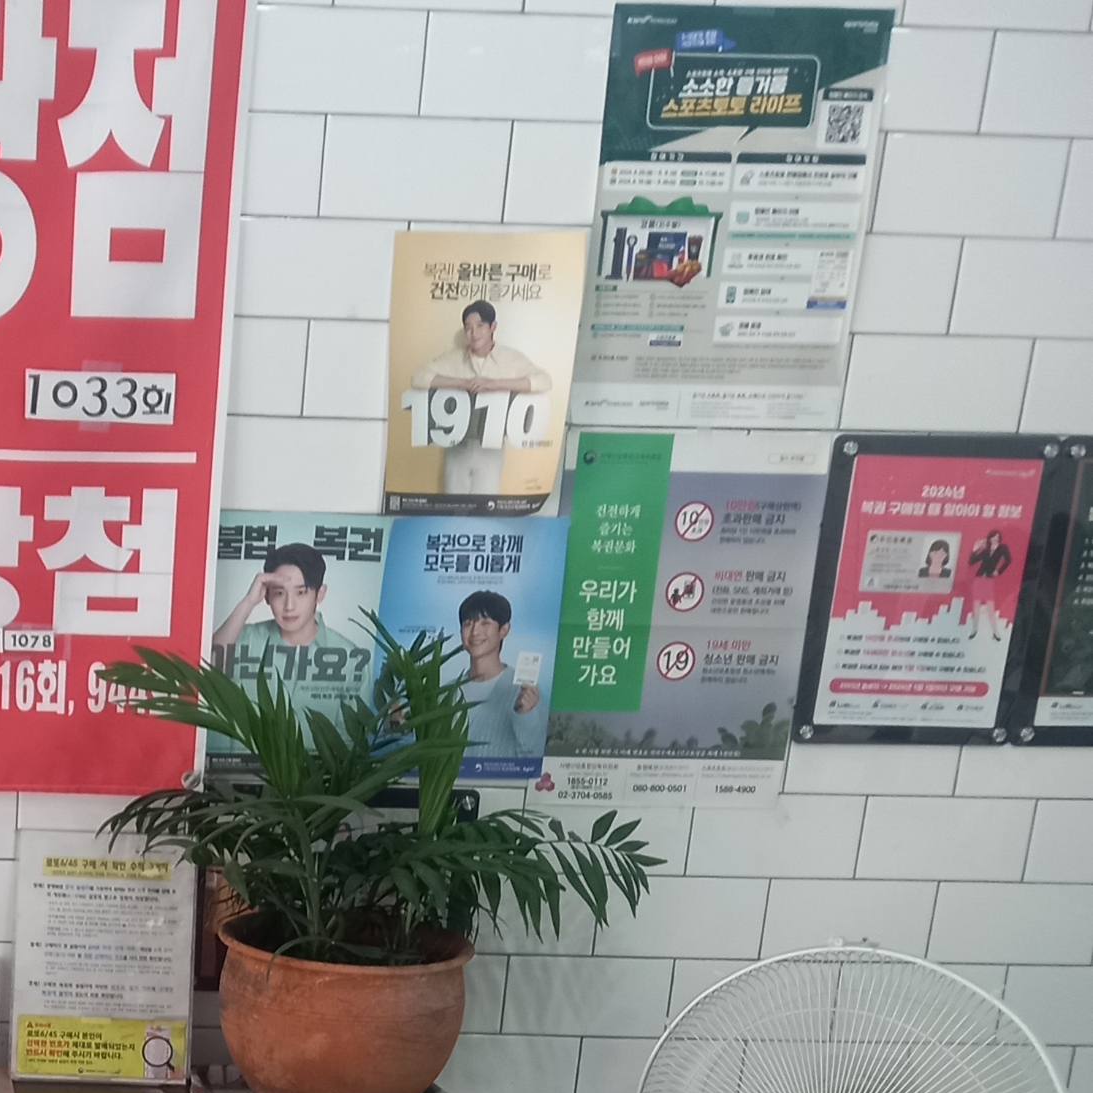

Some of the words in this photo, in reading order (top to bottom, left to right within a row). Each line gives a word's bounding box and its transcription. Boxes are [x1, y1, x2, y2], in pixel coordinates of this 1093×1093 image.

[749, 94, 803, 114] 라이프
[457, 262, 503, 282] 올바른
[505, 262, 552, 282] 구매로
[430, 282, 487, 301] 건전하게
[401, 387, 550, 450] 1910
[921, 485, 967, 499] 2024년
[426, 534, 487, 552] 복권으로
[489, 534, 524, 553] 함께
[423, 554, 471, 573] 모두를
[767, 571, 787, 583] 금지
[578, 579, 638, 604] 우리가
[586, 609, 625, 631] 함께
[10, 634, 53, 650] 1078
[572, 636, 632, 660] 만들어
[663, 650, 690, 672] 19
[758, 654, 780, 666] 금지
[577, 665, 618, 687] 가요
